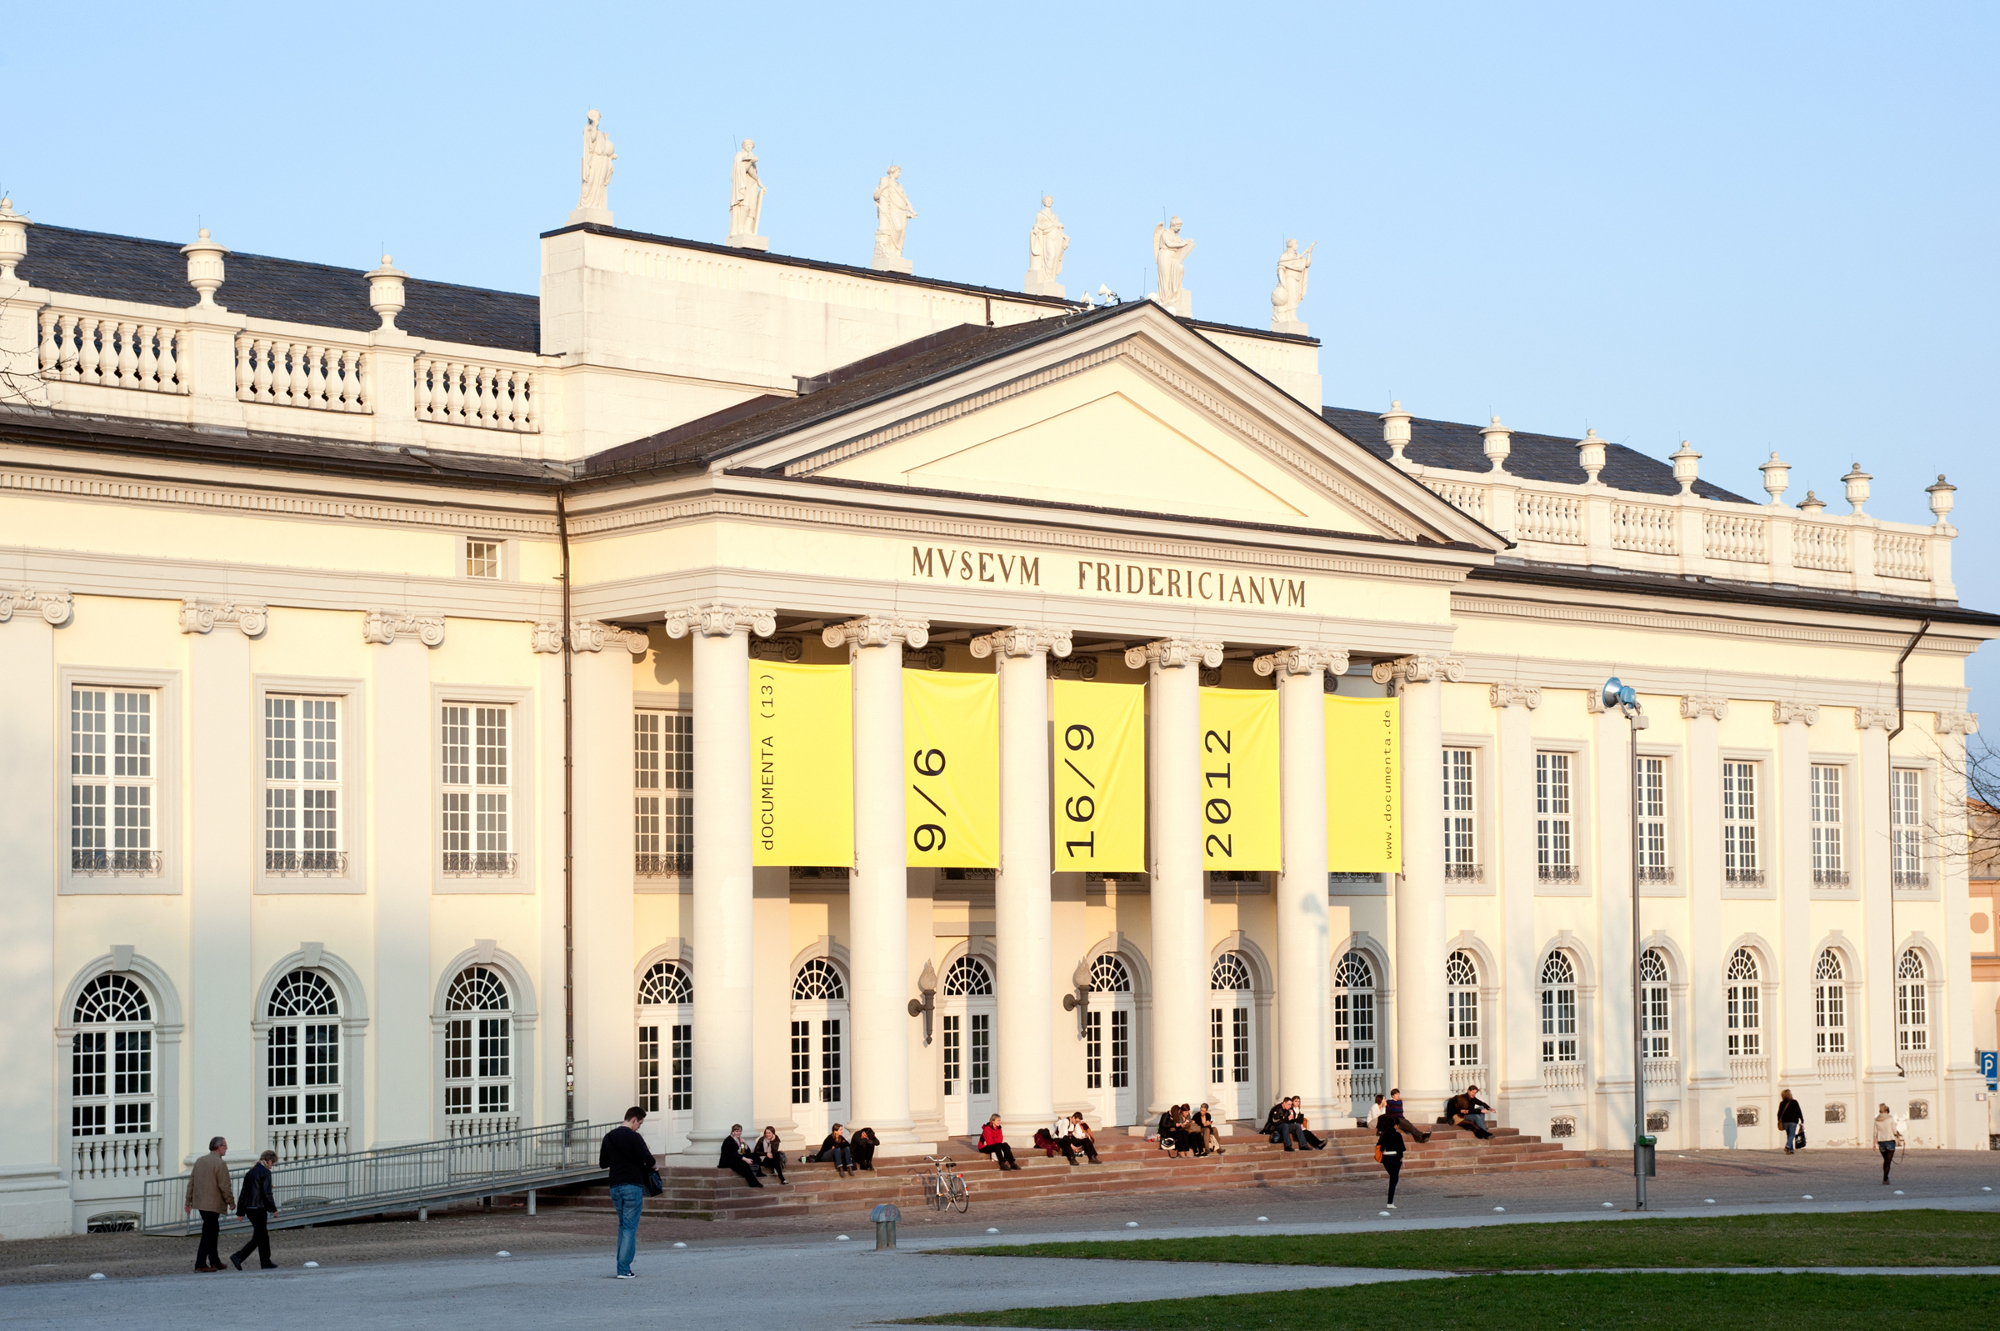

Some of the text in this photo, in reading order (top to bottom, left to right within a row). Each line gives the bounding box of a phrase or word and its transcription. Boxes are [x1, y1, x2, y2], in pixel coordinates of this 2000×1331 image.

[912, 546, 1306, 607] MVSEVM FRIDERICIANVM
[760, 674, 775, 851] dOCUMENTA (13)
[913, 748, 947, 852] 9/6
[1064, 724, 1096, 858] 16/9
[1204, 729, 1233, 858] 2012
[1383, 710, 1393, 860] www.documenta.de
[1984, 1059, 1994, 1076] P
